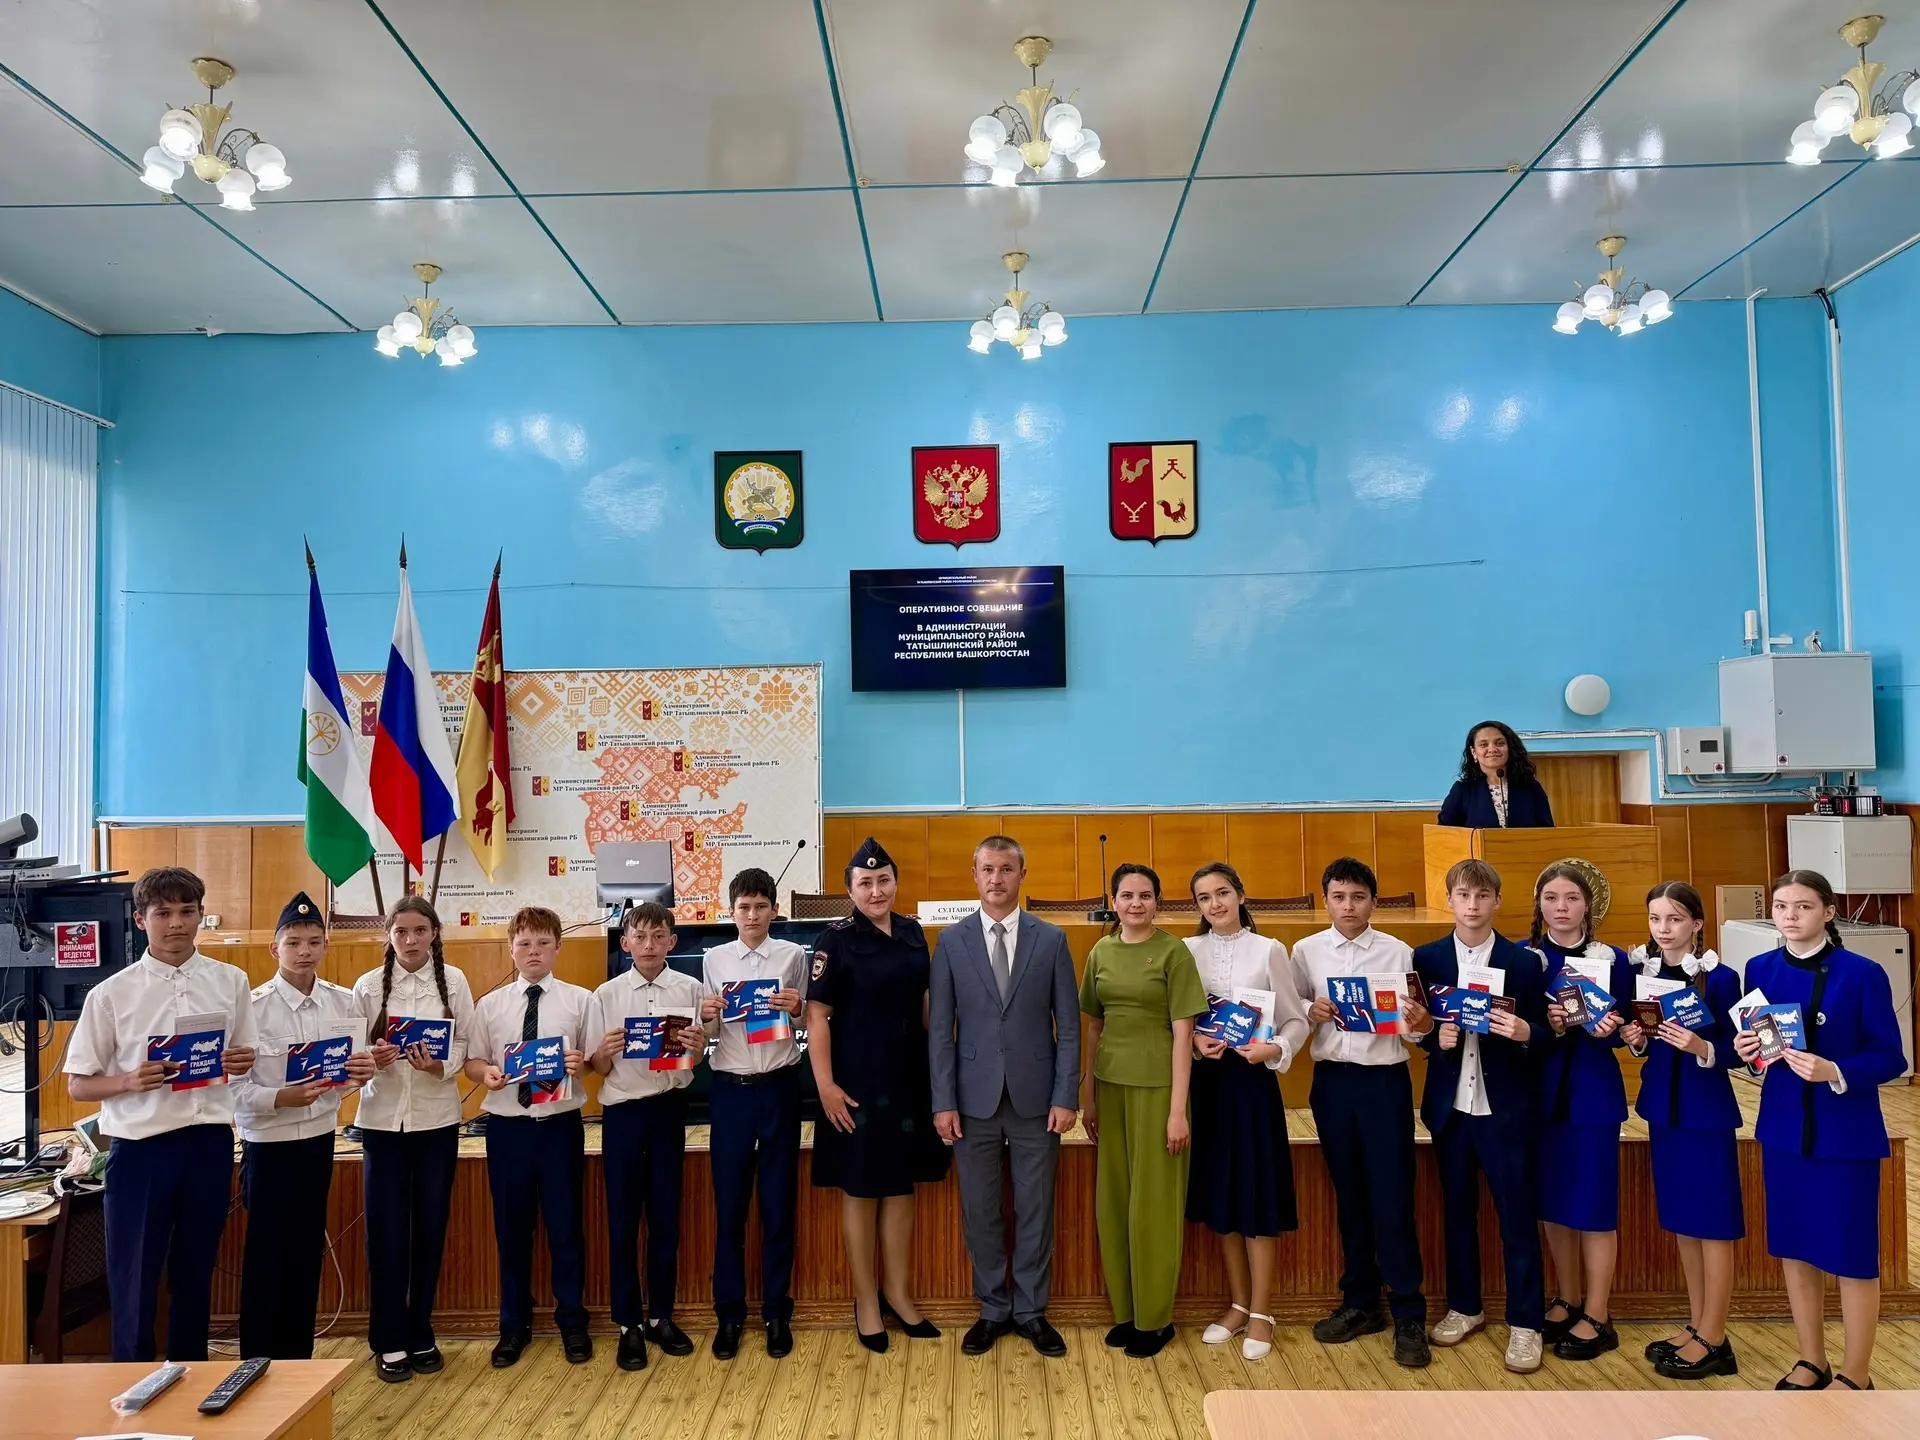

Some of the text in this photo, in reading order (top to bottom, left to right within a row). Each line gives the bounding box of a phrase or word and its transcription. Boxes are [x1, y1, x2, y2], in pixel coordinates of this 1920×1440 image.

[899, 603, 1024, 614] ОПЕРАТИВНОЕ СОВЕЩАНИЕ
[917, 622, 1006, 632] В АДМИНИСТРАЦИИ
[898, 631, 1026, 642] МУНИЦИПАЛЬНОГО РАЙОНА
[906, 640, 1017, 650] ТАТЫШЛИНСКИЙ РАЙОН
[894, 649, 1030, 660] РЕСПУБЛИКИ БАШКОРТОСТАН
[59, 943, 95, 951] ВНИМАНИЕ!
